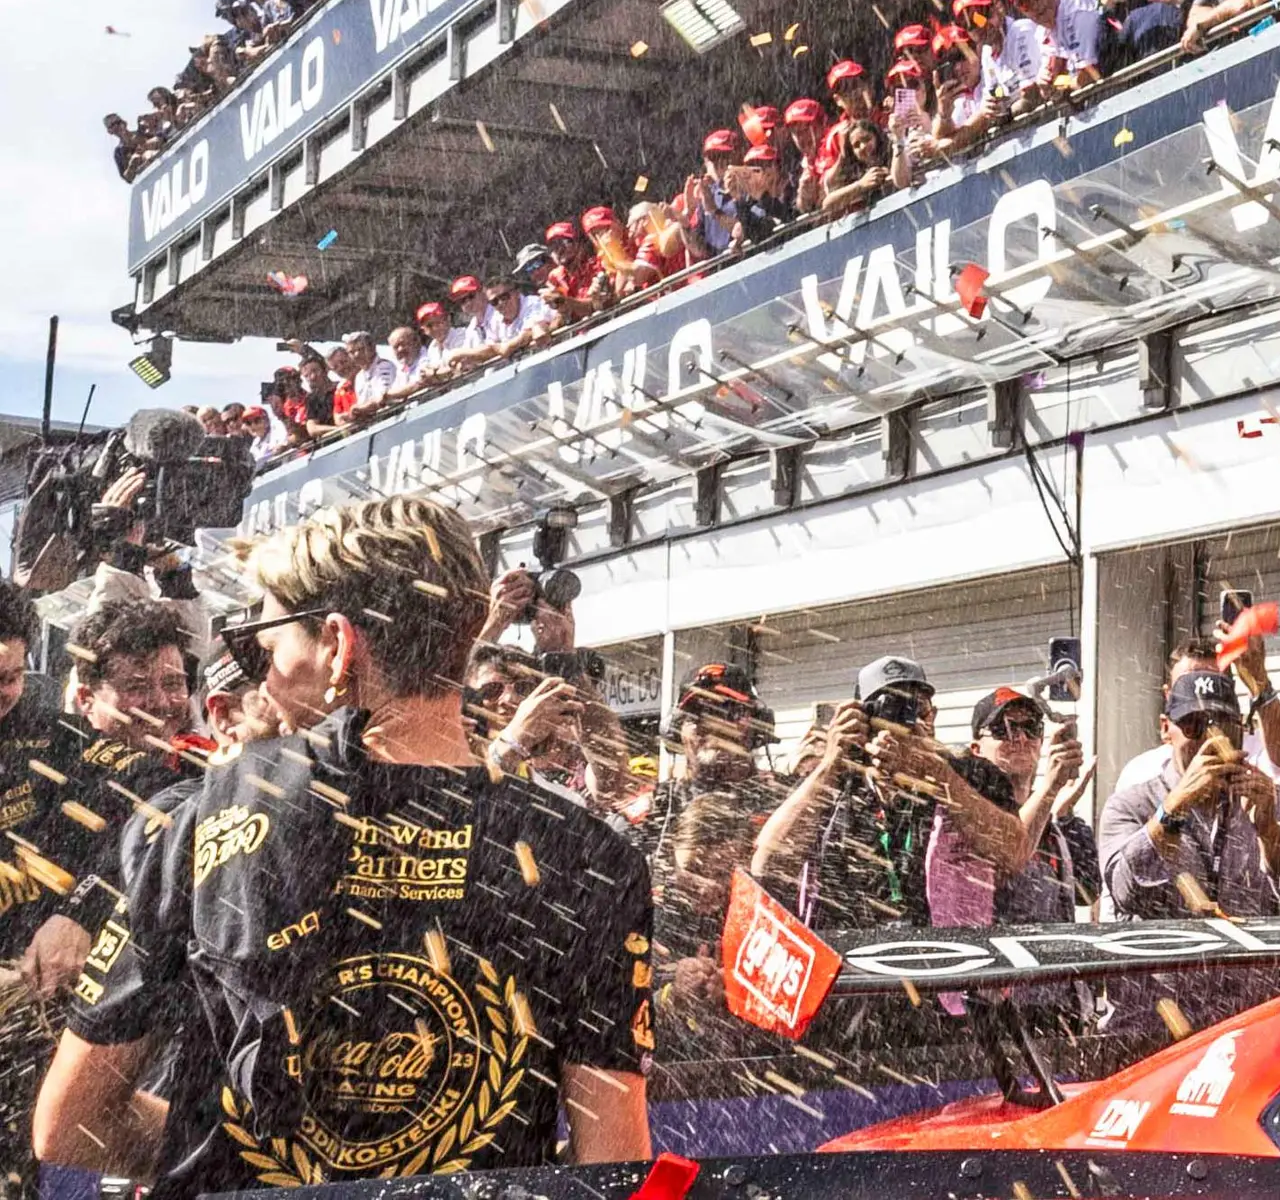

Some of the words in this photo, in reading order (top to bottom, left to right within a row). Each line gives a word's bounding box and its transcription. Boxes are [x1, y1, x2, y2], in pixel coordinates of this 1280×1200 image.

[239, 35, 326, 161] VAILO
[141, 138, 210, 243] VAILO
[801, 178, 1057, 372] VAILO
[399, 885, 465, 901] Services
[338, 1082, 417, 1097] ACING
